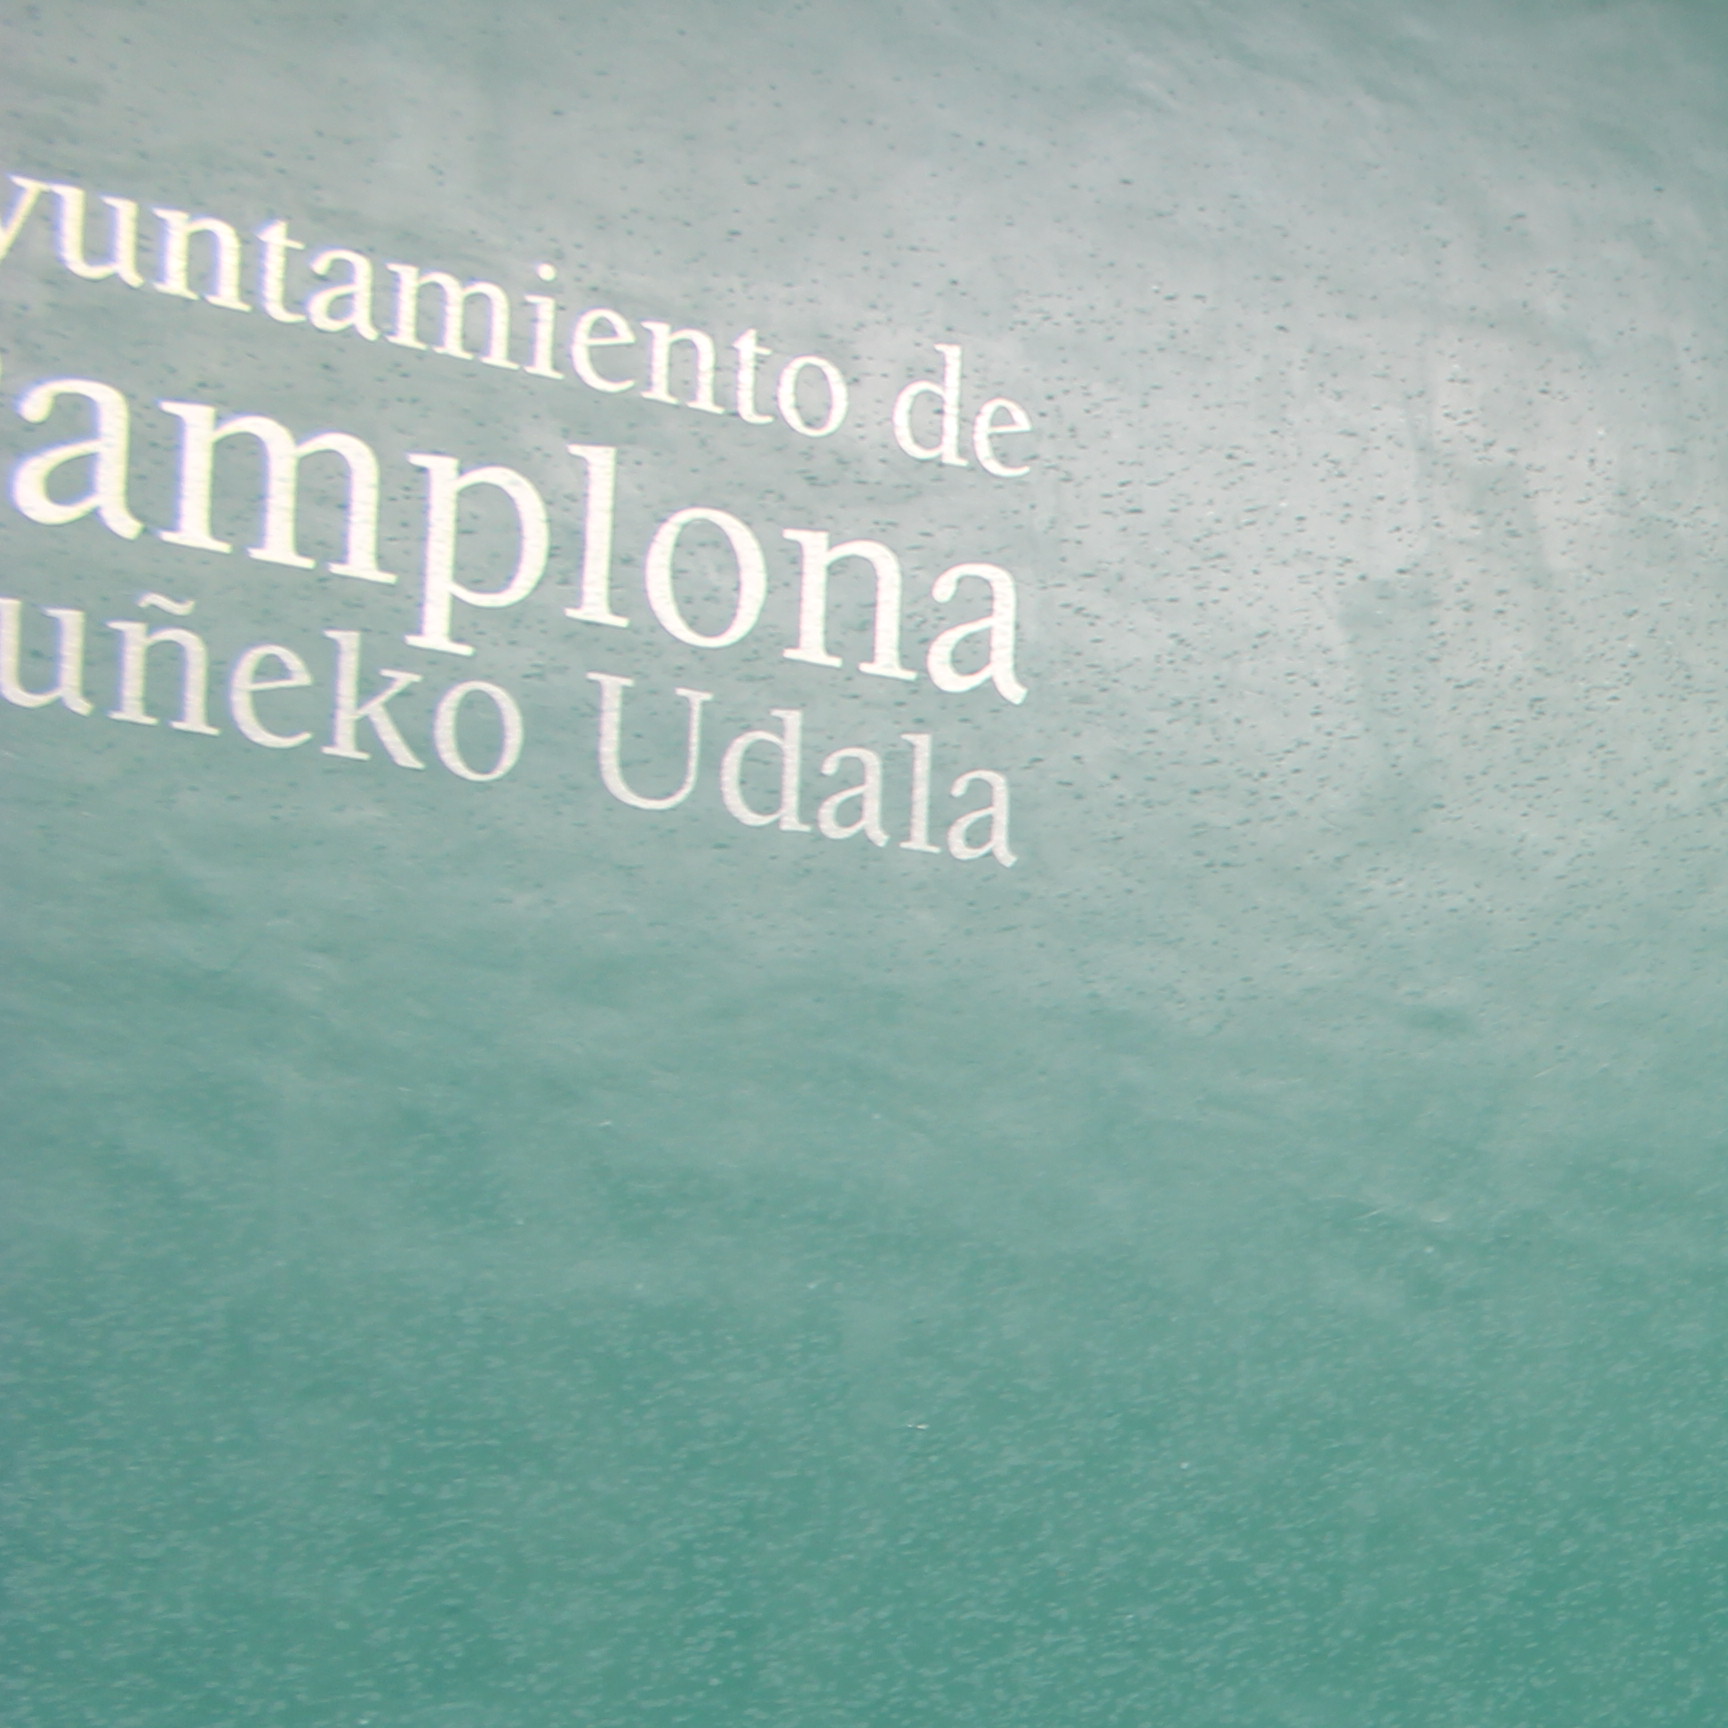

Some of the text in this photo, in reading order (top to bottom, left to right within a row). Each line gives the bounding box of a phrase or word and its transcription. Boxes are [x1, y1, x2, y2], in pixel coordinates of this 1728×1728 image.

[12, 376, 1028, 706] amplona
[892, 344, 1031, 478] de
[0, 593, 1018, 868] uñeko Udala
